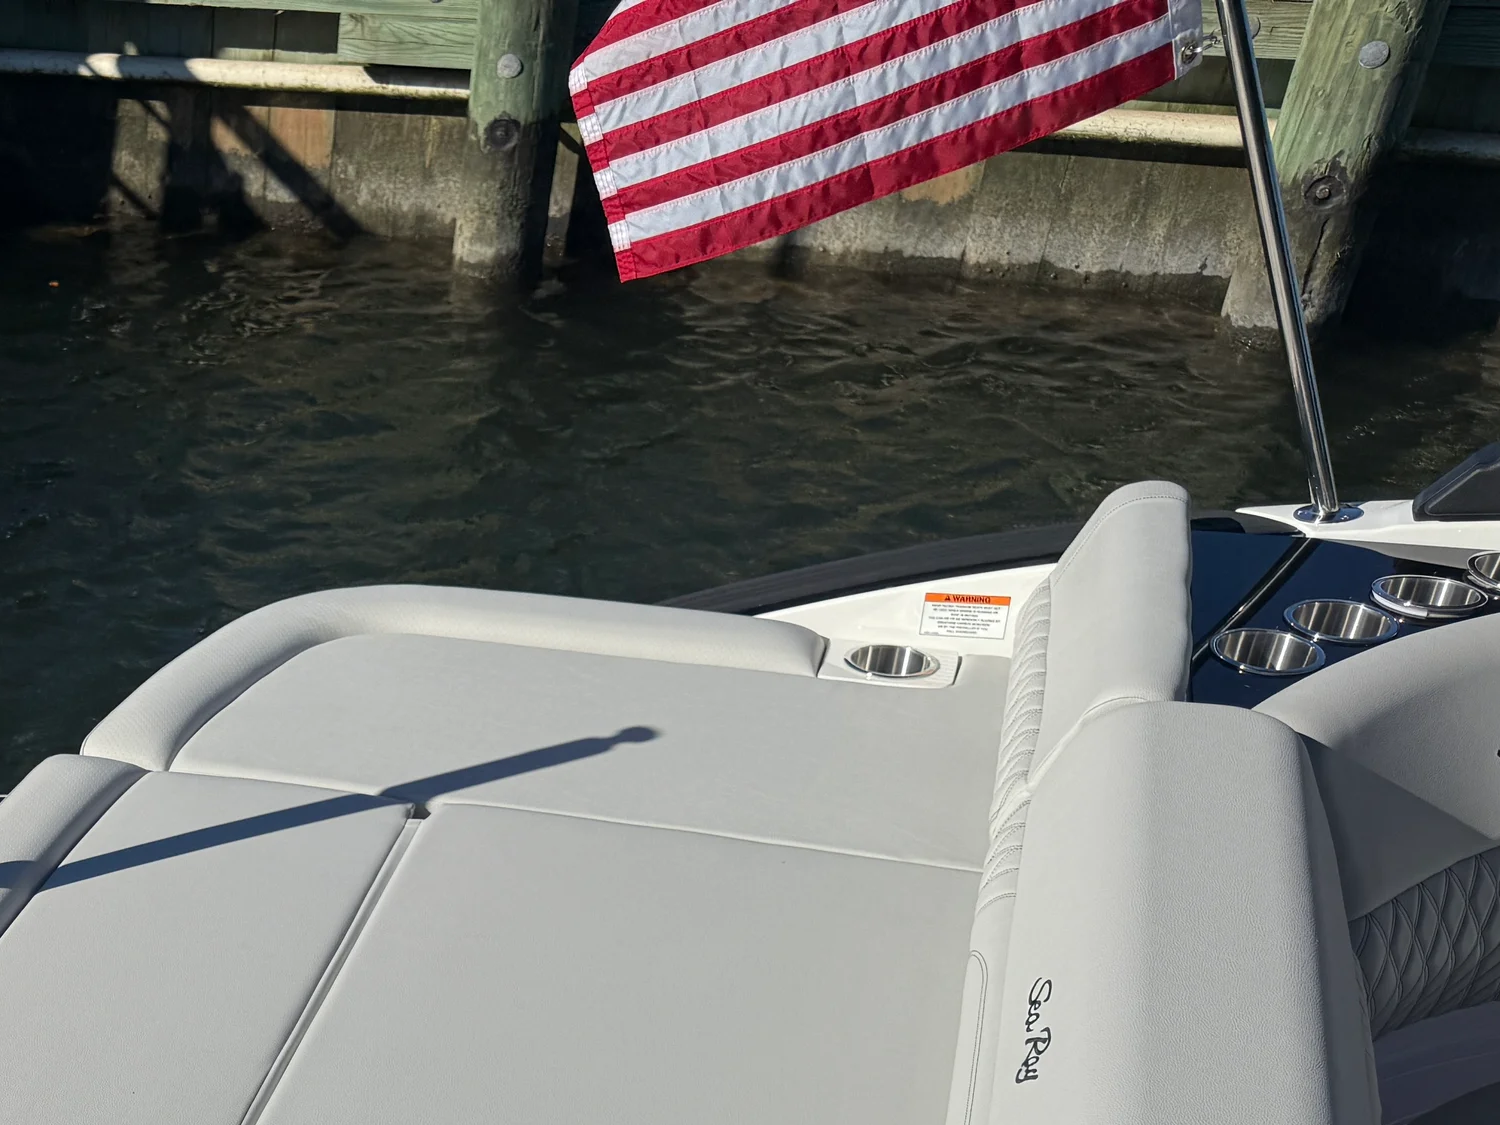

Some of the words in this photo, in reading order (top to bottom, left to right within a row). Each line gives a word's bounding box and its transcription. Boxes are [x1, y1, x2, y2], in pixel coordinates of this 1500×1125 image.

[952, 594, 991, 604] WARNING
[1025, 977, 1052, 1033] Sea
[1015, 1026, 1052, 1084] Ray
